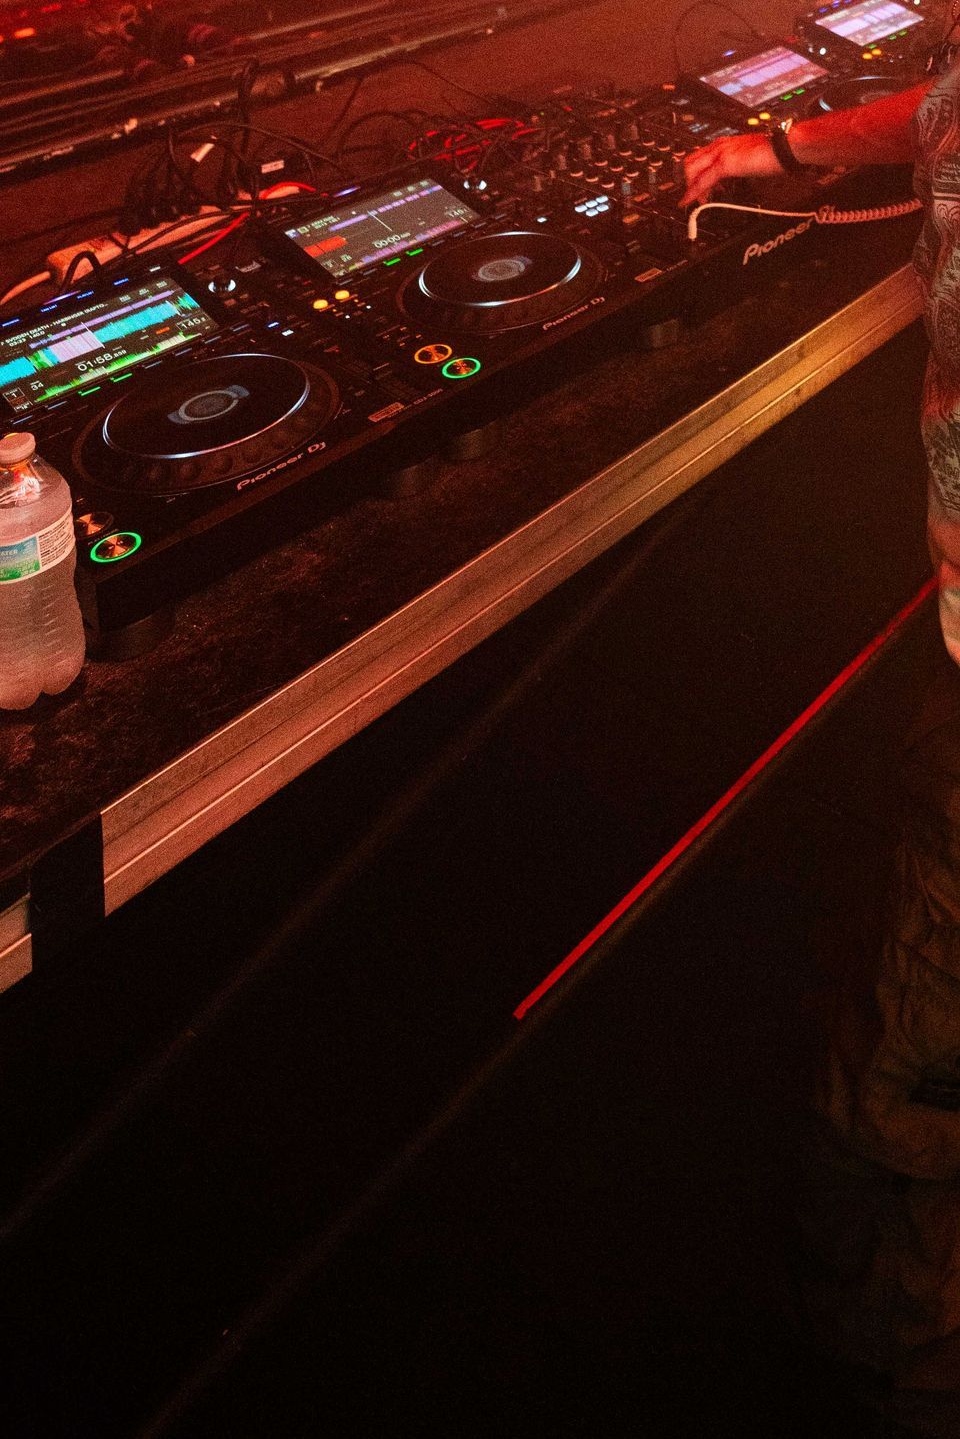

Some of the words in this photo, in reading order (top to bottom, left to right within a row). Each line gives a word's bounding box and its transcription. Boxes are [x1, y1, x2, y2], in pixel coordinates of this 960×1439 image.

[743, 217, 814, 266] Pioneer
[543, 305, 588, 330] Pioneer
[236, 453, 304, 491] Pioneer
